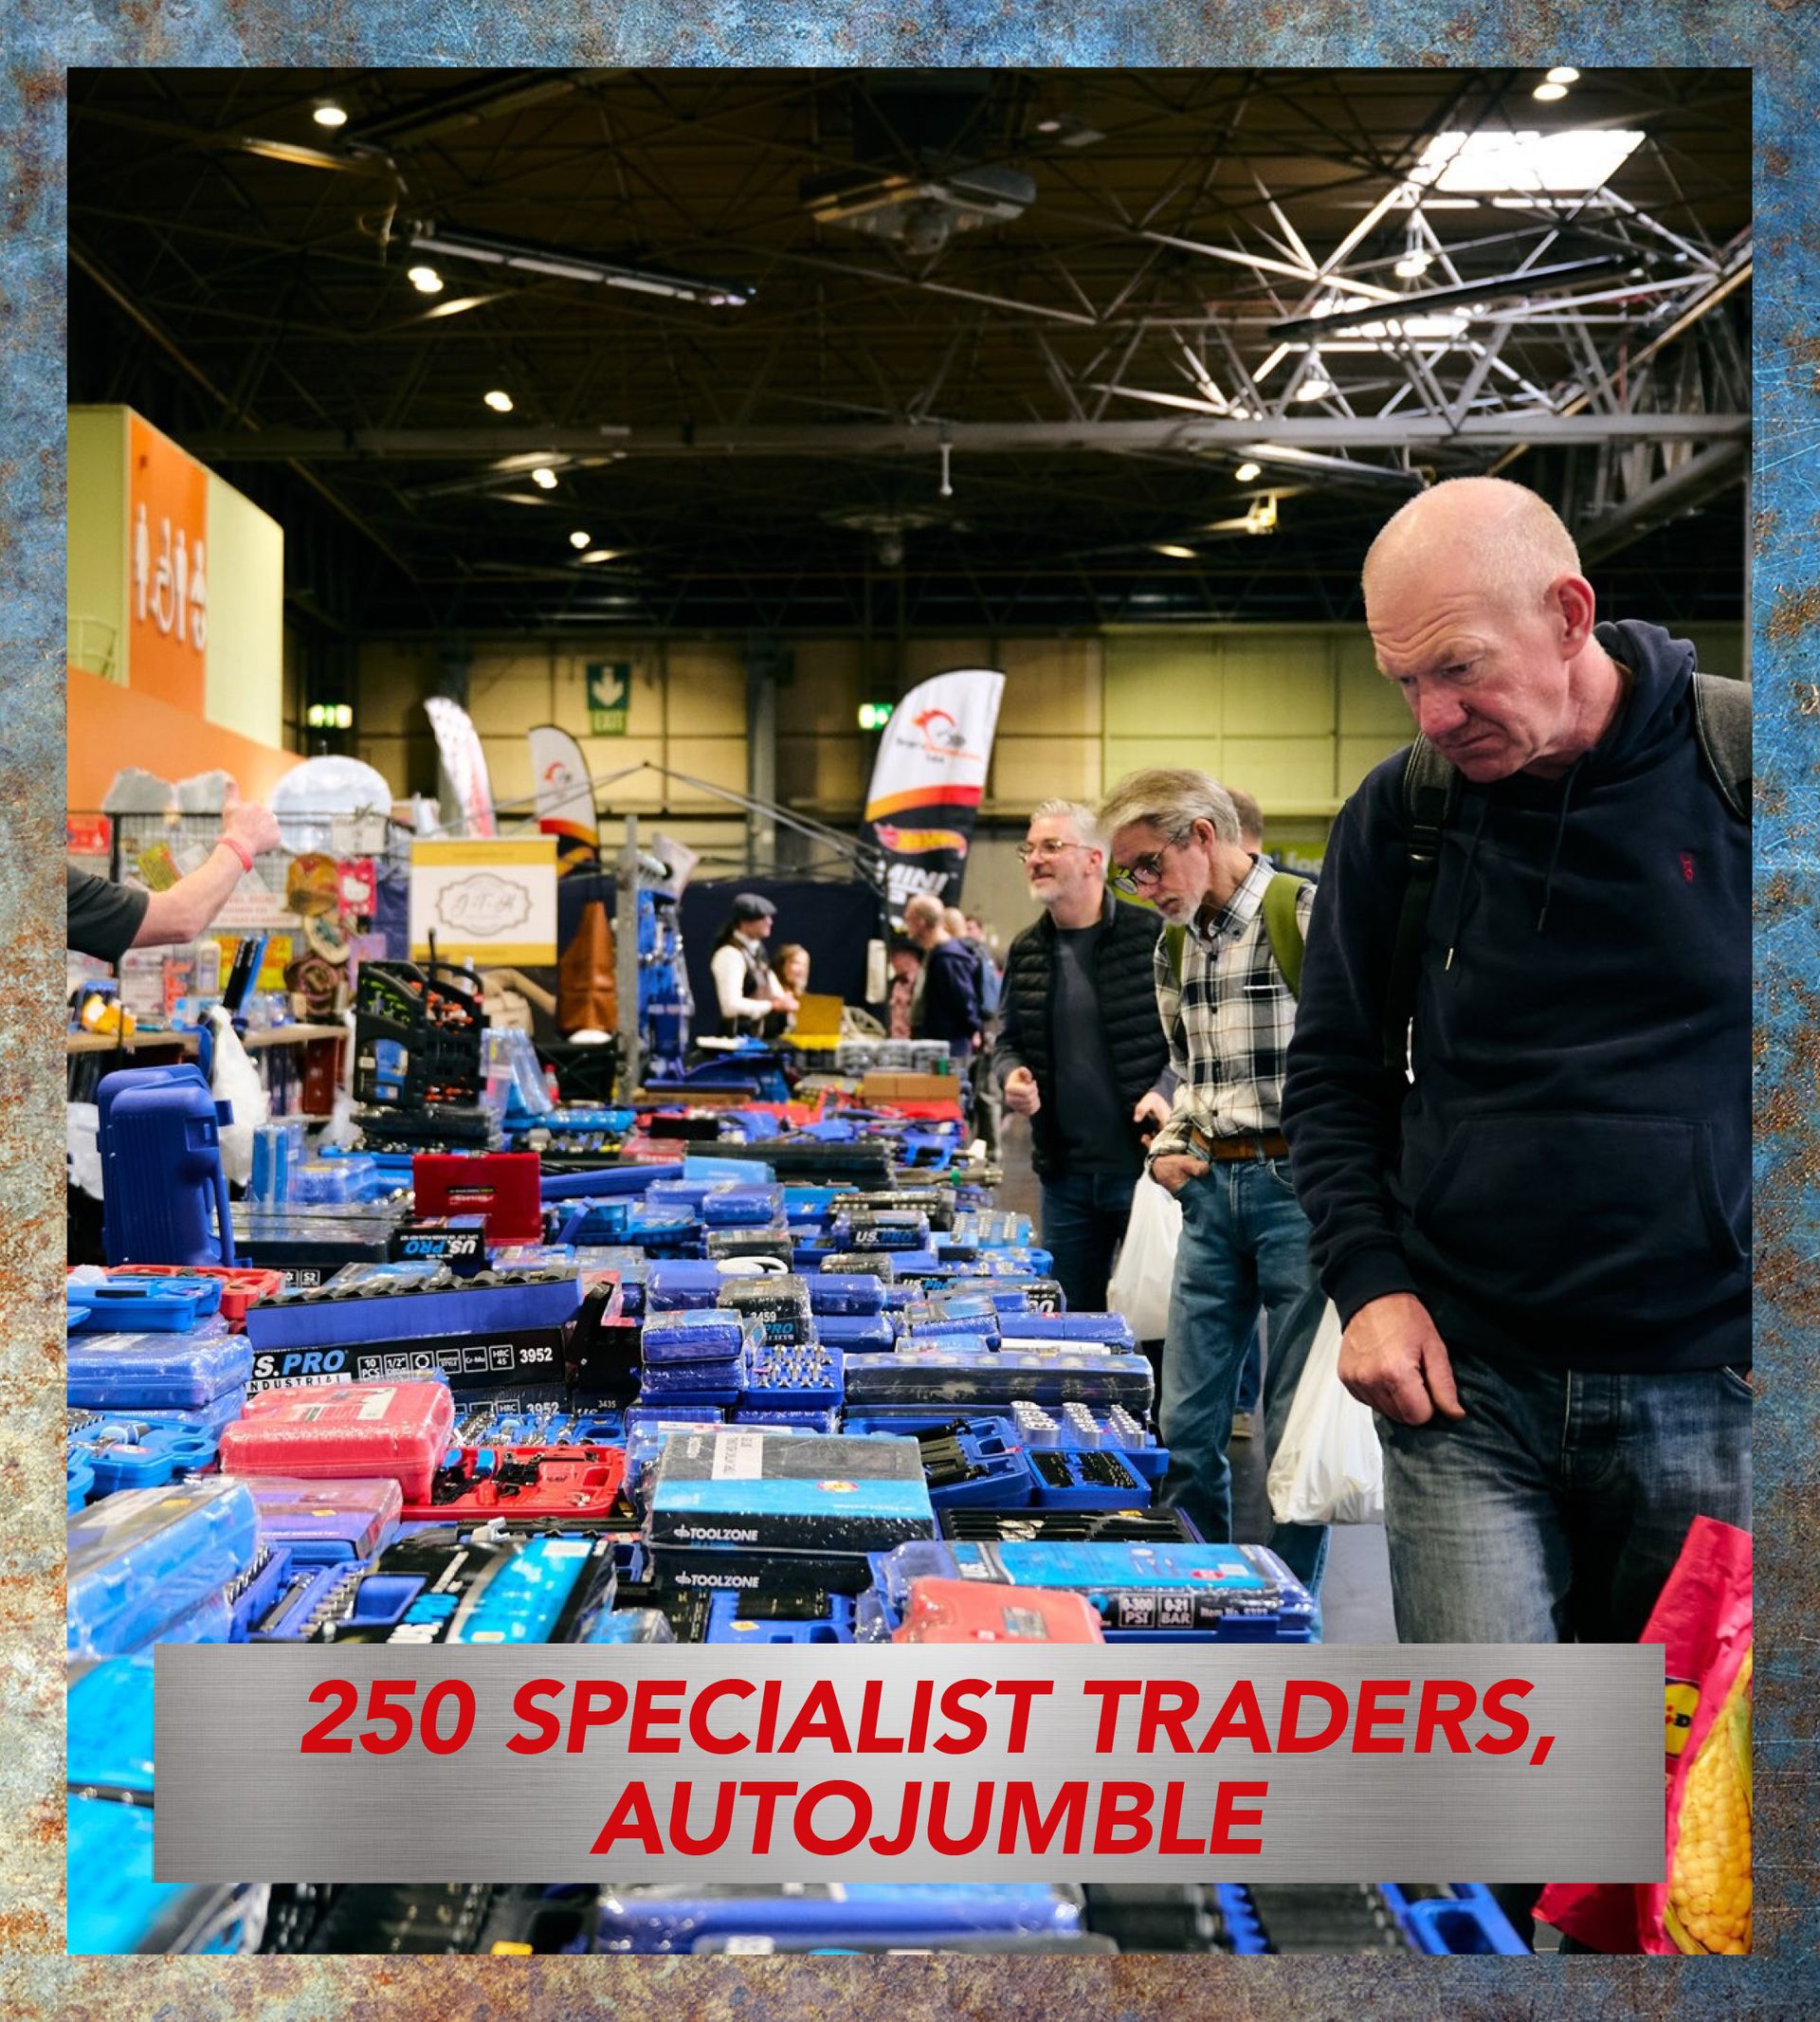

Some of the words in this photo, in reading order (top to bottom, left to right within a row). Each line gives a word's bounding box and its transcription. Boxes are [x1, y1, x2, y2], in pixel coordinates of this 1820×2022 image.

[856, 1230, 913, 1243] US.PRO
[405, 1240, 477, 1254] US.PRO
[519, 1347, 553, 1363] 3952
[252, 1350, 345, 1378] S.PRO
[365, 1359, 376, 1368] 10
[526, 1402, 559, 1414] 3952
[689, 1527, 758, 1541] TOOLZONE
[690, 1574, 759, 1588] TOOLZONE
[1124, 1612, 1149, 1624] PSI
[1160, 1612, 1191, 1624] BAR
